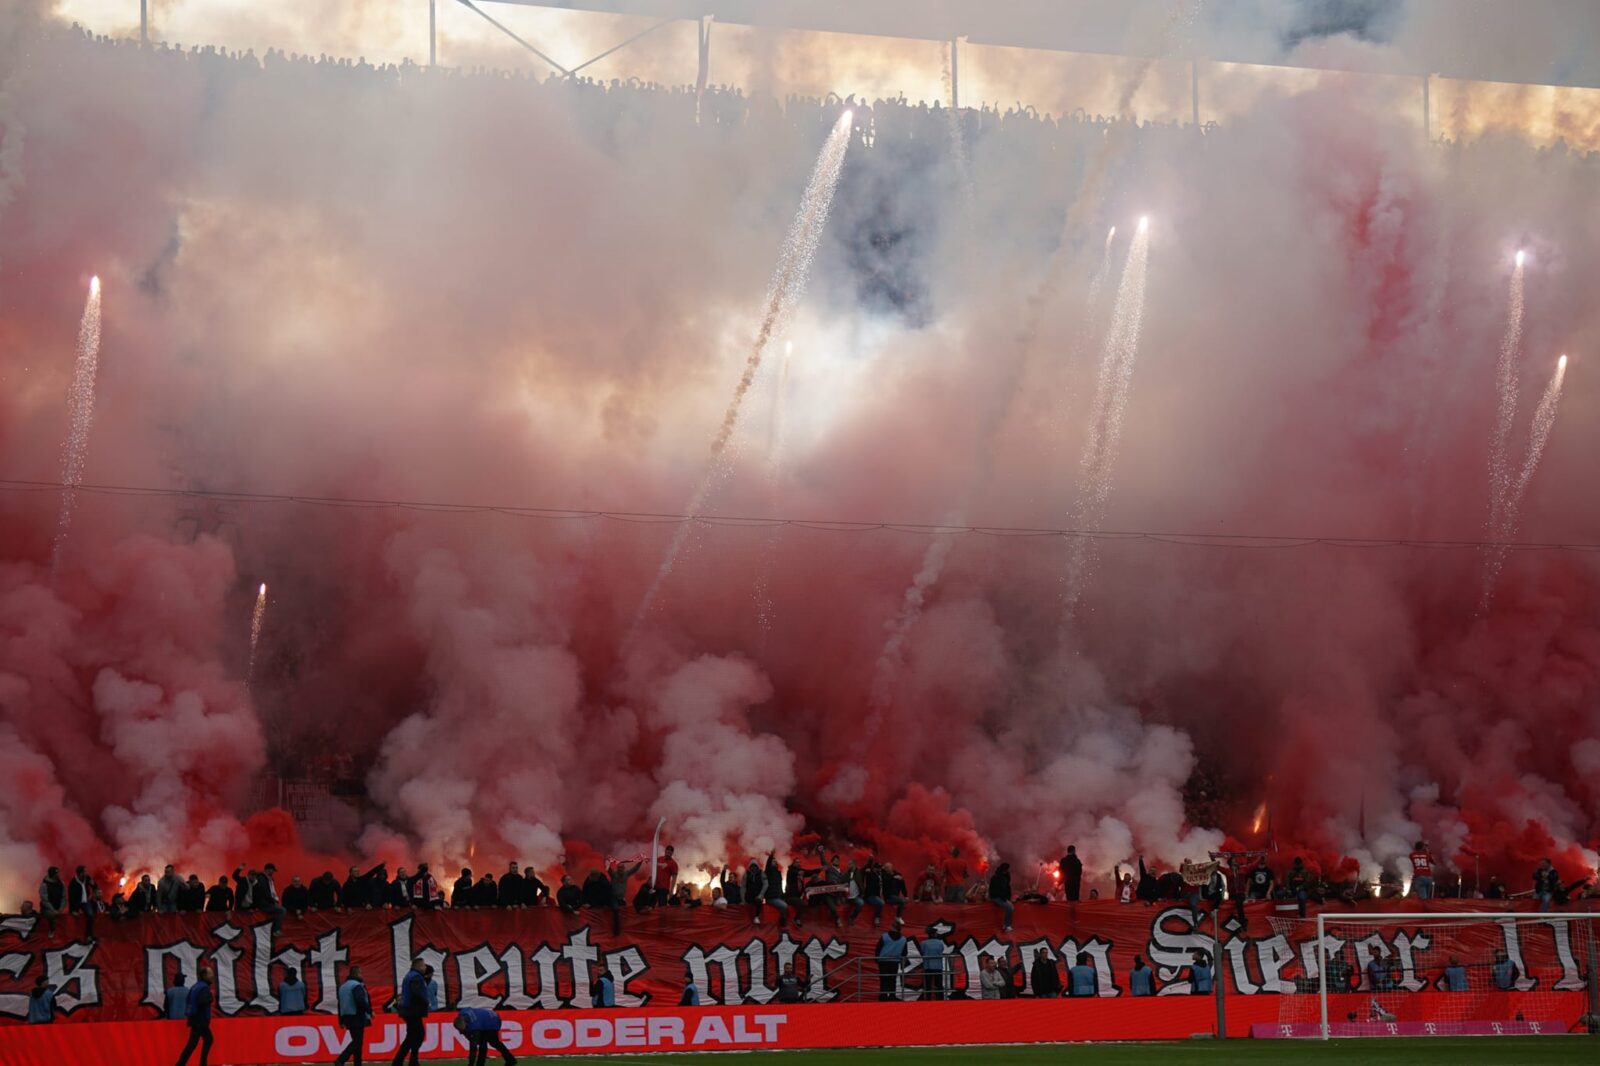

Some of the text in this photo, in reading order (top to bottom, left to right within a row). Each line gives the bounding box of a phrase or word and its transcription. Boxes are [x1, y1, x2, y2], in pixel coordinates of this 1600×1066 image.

[384, 913, 650, 1009] heute
[683, 932, 848, 1005] nur
[1148, 906, 1449, 995] Sieger
[368, 1019, 524, 1055] JUNG
[531, 1015, 686, 1049] ODER
[691, 1013, 788, 1044] ALT
